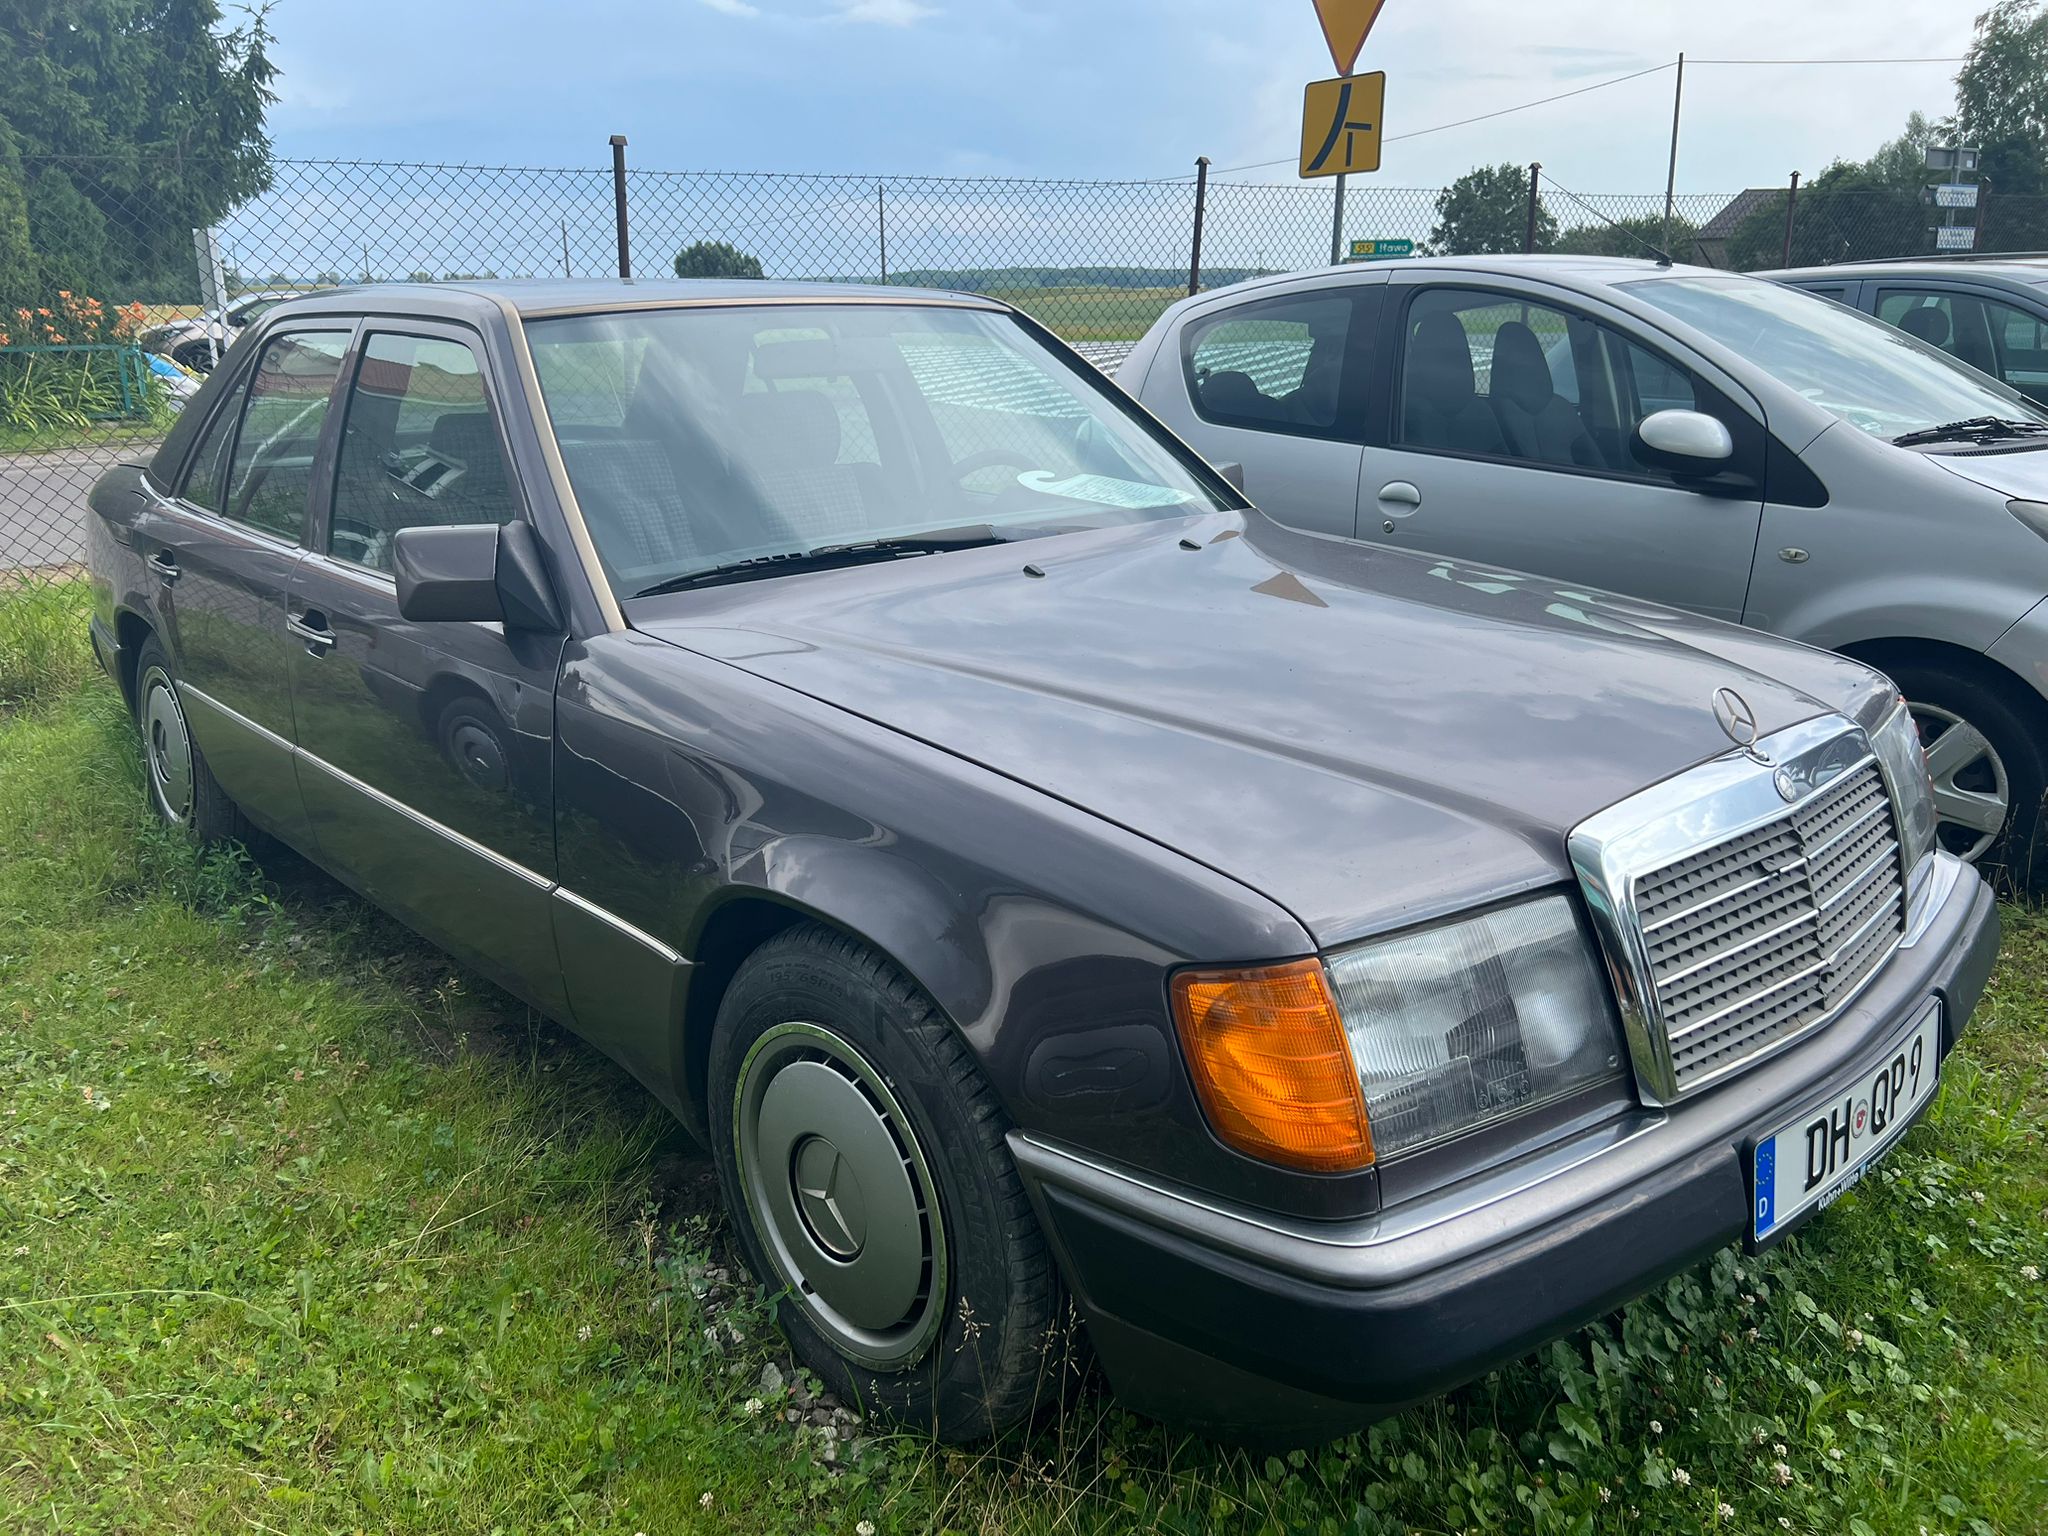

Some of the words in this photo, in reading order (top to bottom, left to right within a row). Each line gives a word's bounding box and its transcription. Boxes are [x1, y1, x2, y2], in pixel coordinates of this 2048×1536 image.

[1804, 1095, 1853, 1193] DH
[1871, 1051, 1905, 1136] QP
[1910, 1034, 1923, 1100] 9
[1758, 1196, 1768, 1219] D
